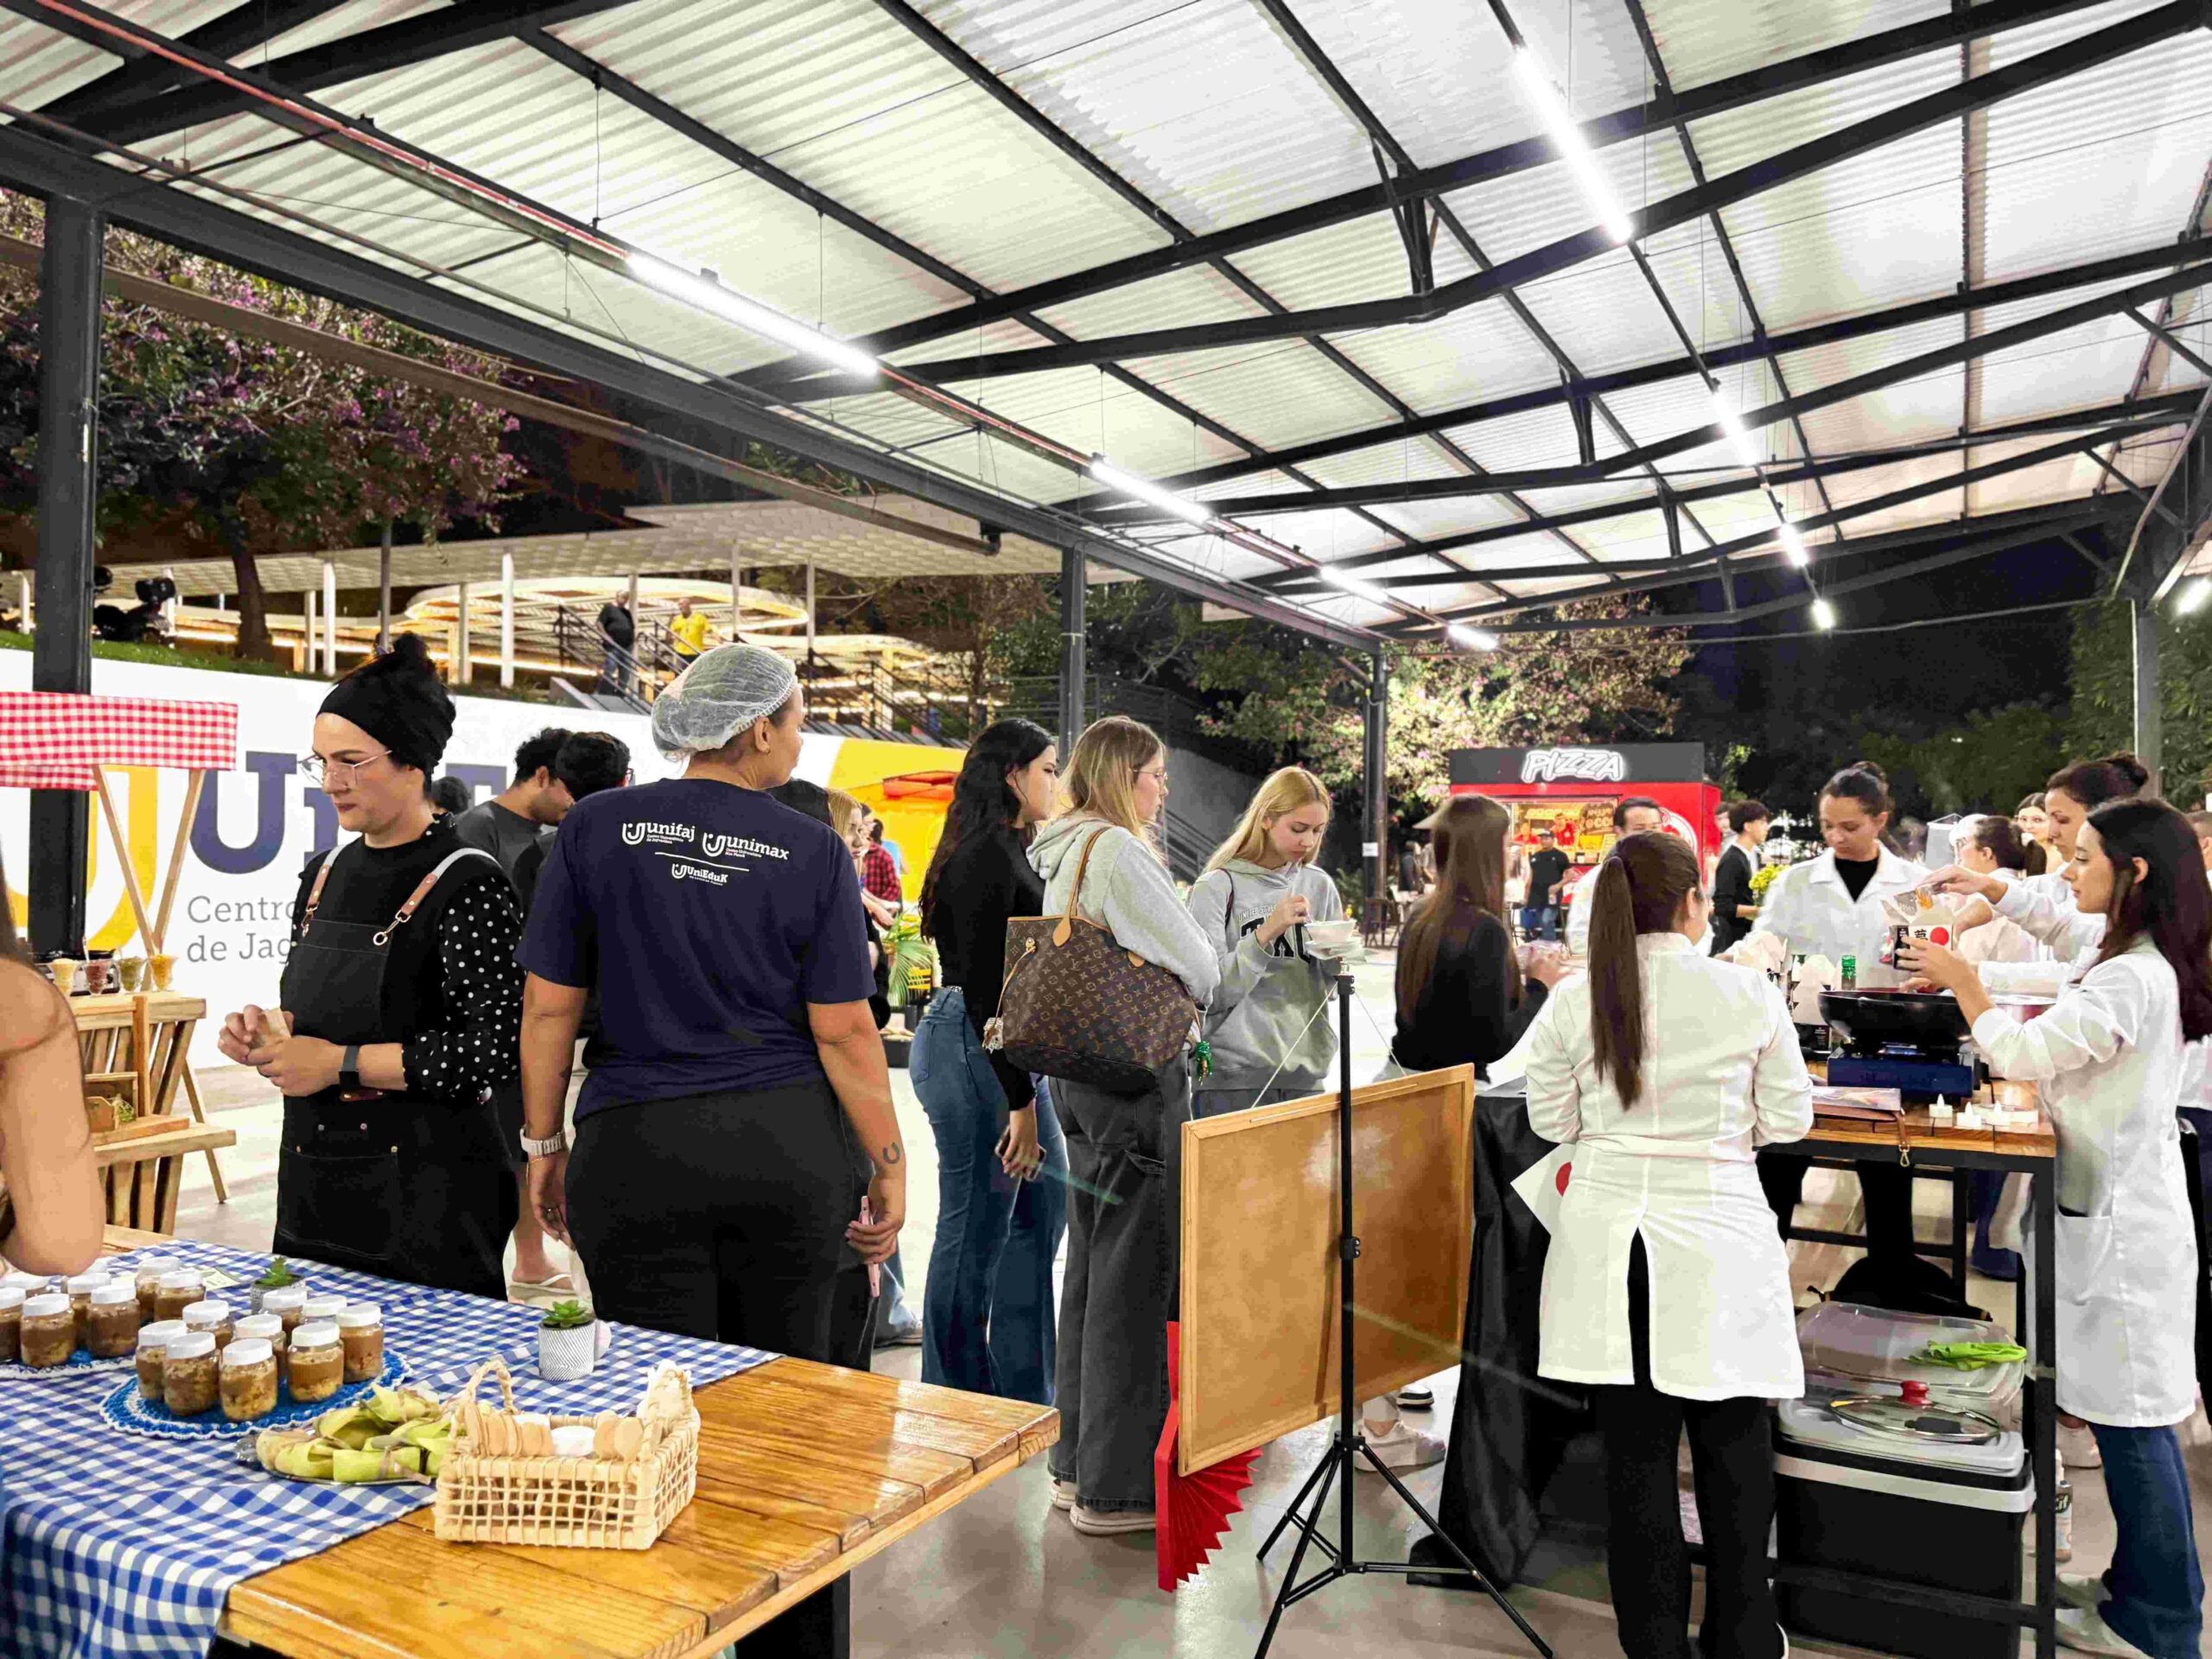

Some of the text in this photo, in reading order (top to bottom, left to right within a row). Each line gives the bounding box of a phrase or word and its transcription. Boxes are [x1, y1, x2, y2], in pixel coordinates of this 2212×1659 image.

[1522, 748, 1624, 783] PIZZA
[647, 822, 696, 842] unifaj
[727, 836, 790, 861] unimax
[687, 866, 728, 883] UniEduK
[187, 935, 227, 963] de
